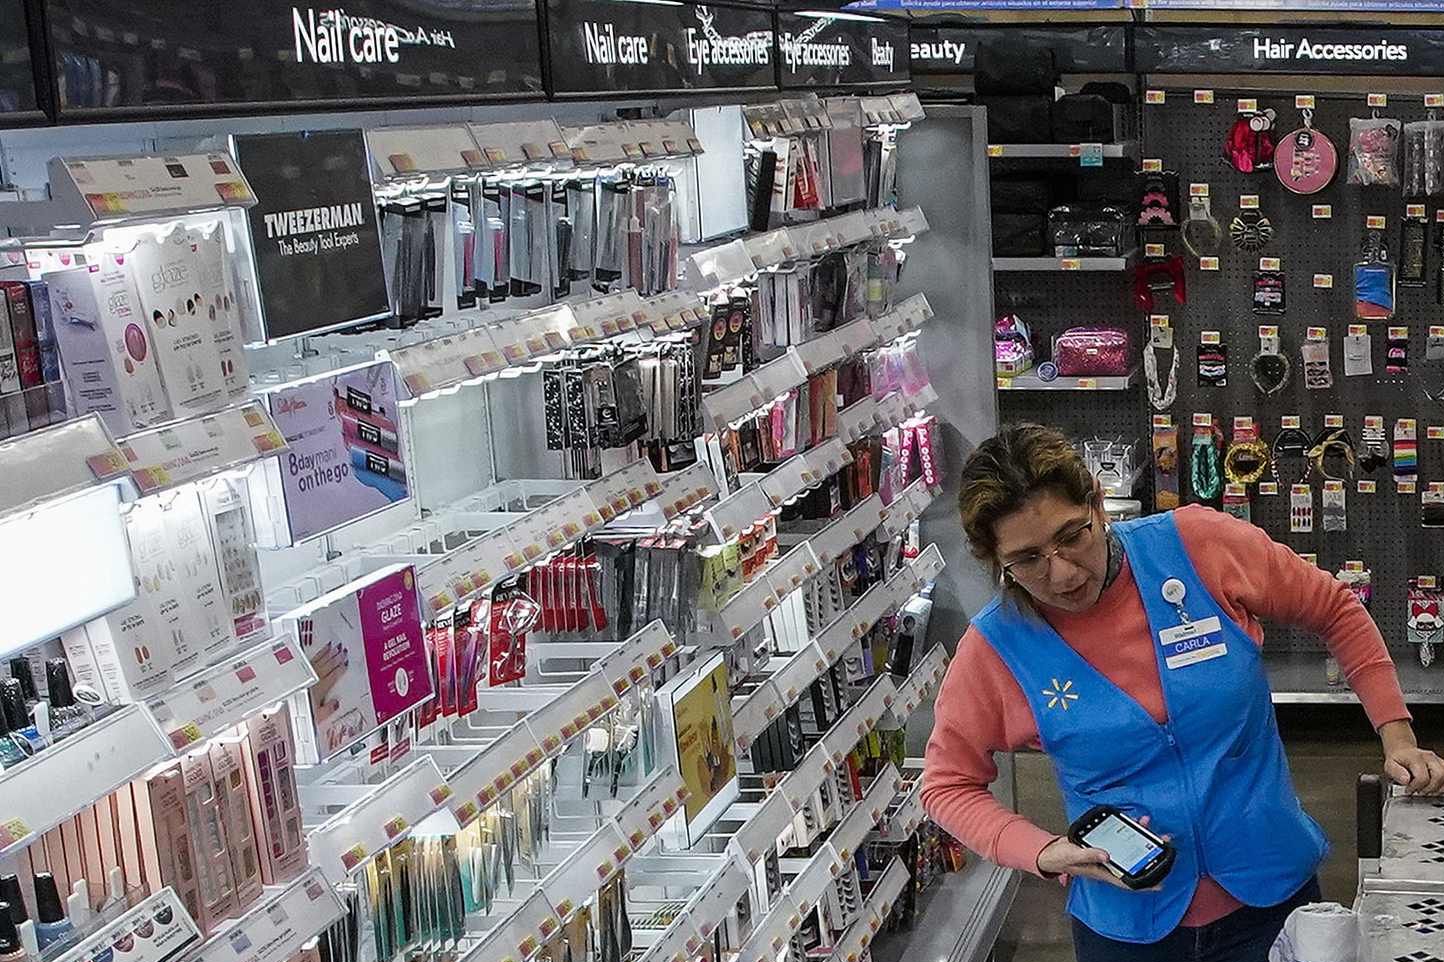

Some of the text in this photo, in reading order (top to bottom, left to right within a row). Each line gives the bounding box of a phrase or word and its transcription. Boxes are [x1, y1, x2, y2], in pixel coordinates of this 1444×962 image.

[292, 7, 344, 63] Nail
[349, 26, 400, 63] care
[585, 22, 648, 64] Nail care
[1254, 38, 1408, 60] Hair Accessories
[687, 27, 768, 75] Eye accessories
[784, 32, 850, 73] Eye accessories
[911, 42, 966, 64] eauty
[264, 203, 366, 239] TWEEZERMAN
[278, 231, 360, 256] The Beauty Tool Experts
[381, 603, 402, 623] GLAZE
[1175, 636, 1211, 653] CARLA
